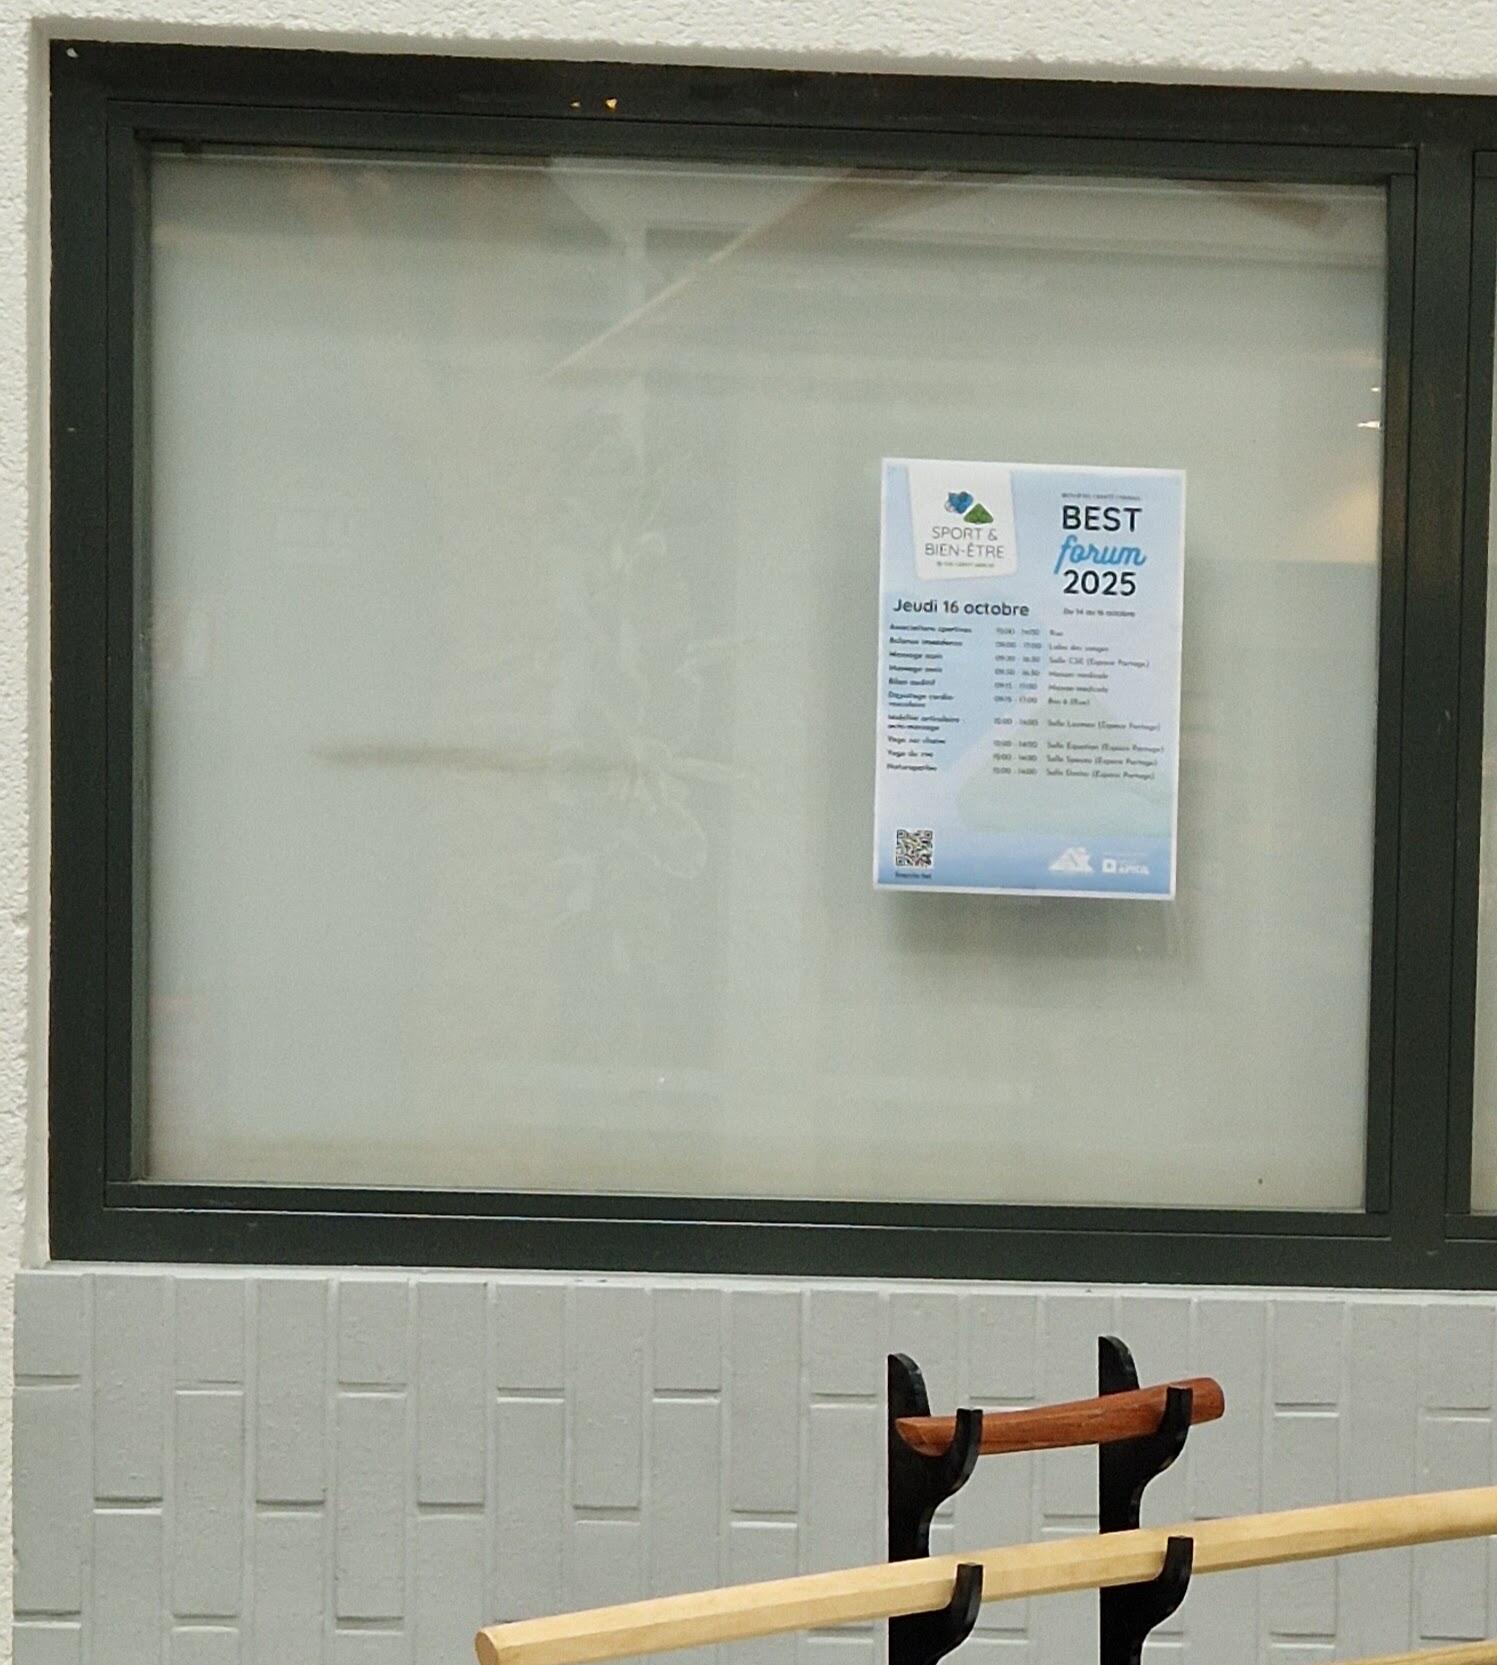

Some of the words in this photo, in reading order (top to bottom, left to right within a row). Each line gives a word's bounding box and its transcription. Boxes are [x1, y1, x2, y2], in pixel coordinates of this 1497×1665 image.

[1063, 506, 1142, 532] BEST
[932, 526, 982, 540] SPORT
[988, 528, 998, 542] &
[925, 542, 1004, 558] BIEN-ÊTRE
[1054, 535, 1146, 574] forum
[1064, 570, 1135, 595] 2025
[894, 599, 938, 614] Jeudi
[943, 602, 959, 614] 16
[964, 602, 1029, 617] octobre
